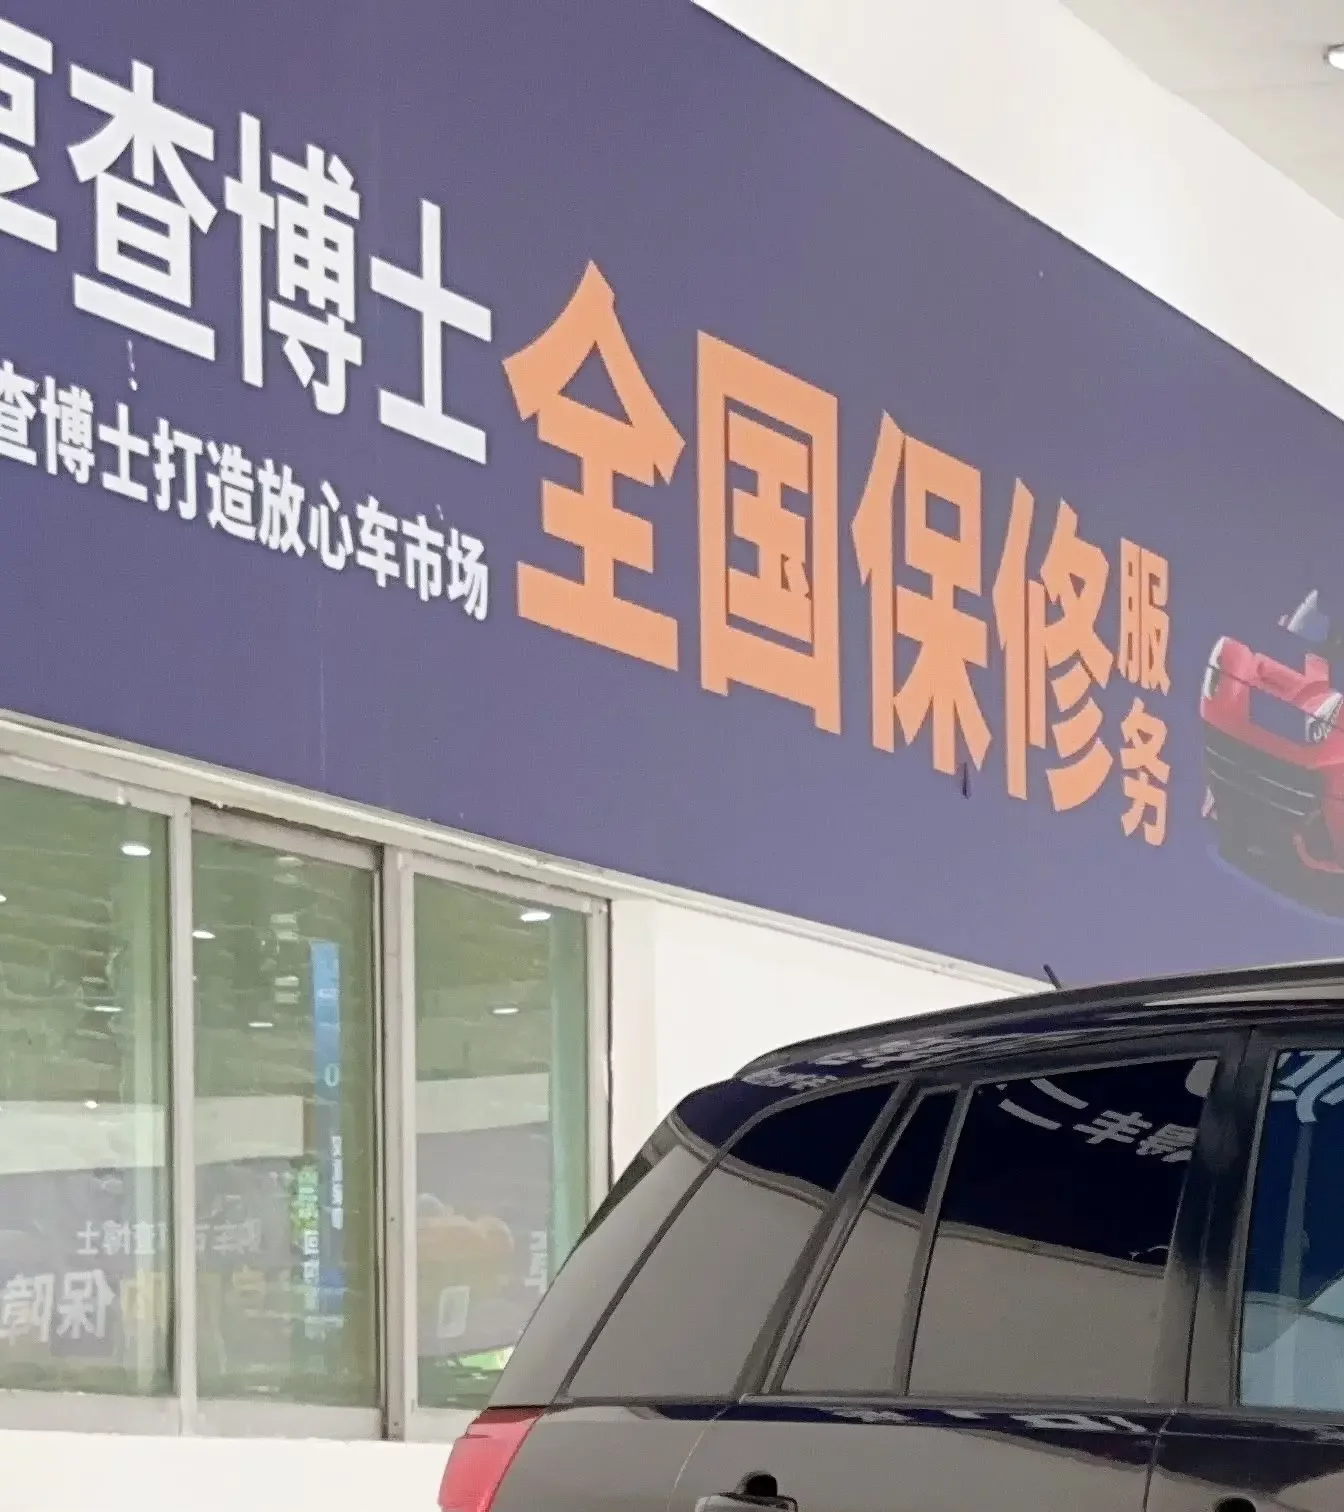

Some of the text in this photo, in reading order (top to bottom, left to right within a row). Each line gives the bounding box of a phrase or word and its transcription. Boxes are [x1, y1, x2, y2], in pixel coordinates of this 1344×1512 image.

[502, 260, 1113, 812] 全国保修
[1118, 537, 1171, 847] 服务
